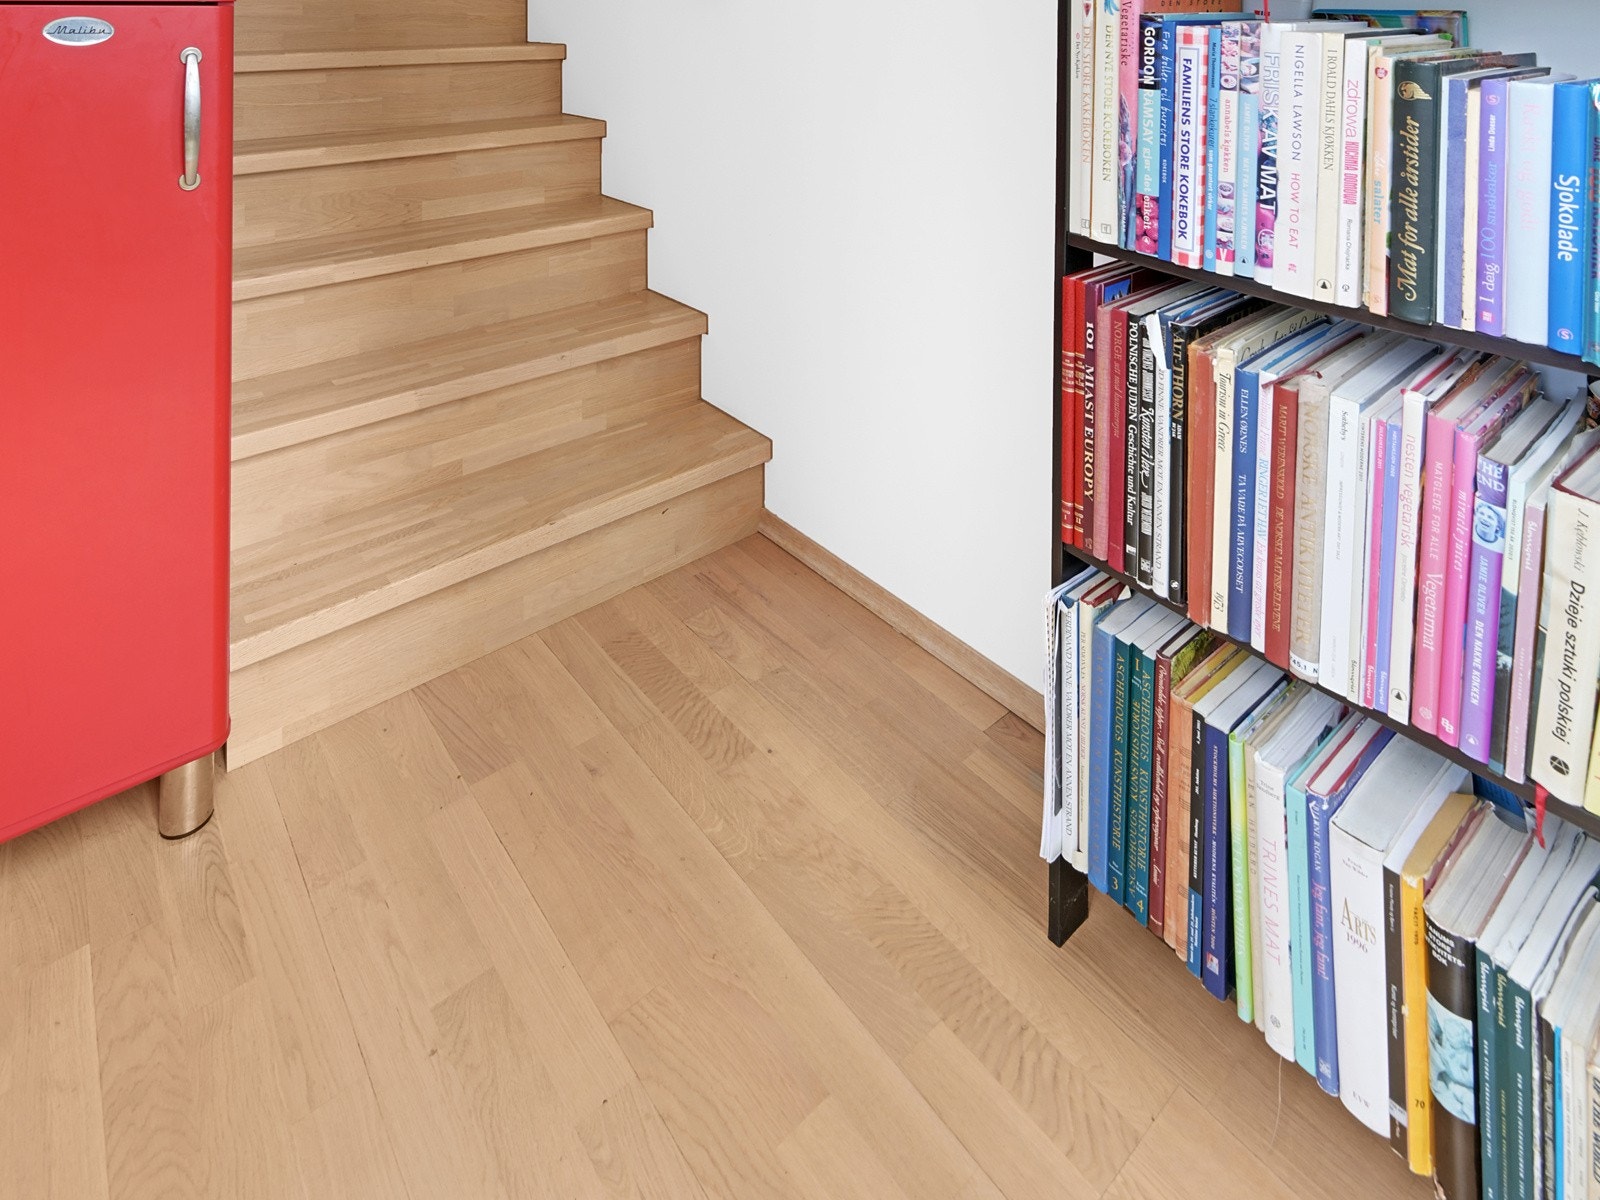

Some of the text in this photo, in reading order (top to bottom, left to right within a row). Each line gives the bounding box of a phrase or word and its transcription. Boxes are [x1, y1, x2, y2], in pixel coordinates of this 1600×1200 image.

[50, 25, 111, 36] Malibu
[1120, 1, 1132, 67] Vegetariske
[1161, 0, 1181, 7] DEN
[1082, 25, 1091, 163] DEN STORE KAKEBOKEN
[1102, 24, 1114, 183] DEN NYE STORE KOKEBOKEN
[1142, 27, 1155, 230] GORDON RAMSAY det enkelt
[1160, 87, 1171, 147] til burritos
[1208, 103, 1217, 148] slankekurer
[1322, 55, 1337, 171] ROALD DAHLS KJØKKEN
[1178, 58, 1192, 240] FAMILIENS STORE KOKEBOK
[1220, 99, 1232, 173] annabels kjøkken
[1259, 51, 1281, 216] FRISK AV MAT
[1289, 45, 1304, 249] NIGELLA LAWSON HOW TO EAT
[1343, 79, 1361, 206] zdrowa KUCHNIA DOMOWA
[1374, 179, 1386, 225] salater
[1397, 115, 1425, 302] Mat for alle årstider
[1555, 174, 1581, 262] Sjokolade
[1484, 262, 1500, 292] deig
[1113, 321, 1122, 361] NORGE
[1084, 321, 1095, 502] 101 MIAST EUROPY
[1126, 321, 1139, 526] POLNISCHE JUDEN Geschichte und Kultur
[1139, 407, 1154, 449] Kunsten
[1217, 372, 1232, 453] Tourism in Greece
[1339, 410, 1349, 442] Sotheby's
[1235, 388, 1249, 594] ELLEN ØRNES TA VARE PÅ ARVEGODSET
[1274, 404, 1288, 555] MARIT WERENSKIOLD DE NORSKE
[1400, 434, 1418, 549] nesten vegetarisk
[1429, 461, 1443, 560] MATGLEDE FOR ALLE
[1455, 489, 1470, 534] miracle
[1154, 532, 1162, 569] STRAND
[1256, 519, 1267, 541] HAV
[1295, 402, 1321, 645] NORSKE ANTIKVITETER
[1422, 572, 1443, 652] Vegetarmat
[1470, 555, 1488, 706] JAMIE OLIVER DEN NAKNE KOKKEN
[1114, 652, 1125, 744] ASCHEHOUGS
[1551, 580, 1586, 745] Dzieje sztuki polskiej
[1065, 691, 1073, 730] VANDRER
[1139, 670, 1151, 762] ASCHEHOUGS
[1066, 751, 1073, 766] EN
[1065, 801, 1073, 836] STRAND
[1112, 748, 1124, 851] KUNSTHISTORIE
[1137, 768, 1150, 872] KUNSTHISTORIE
[1111, 876, 1119, 890] 3
[1312, 880, 1327, 902] Jeg
[1313, 839, 1322, 873] ROGAN
[1136, 900, 1144, 913] 4
[1262, 837, 1281, 967] TRINES MAT
[1312, 930, 1328, 951] jeg
[1341, 897, 1377, 946] ARTS
[1346, 931, 1368, 954] 1996
[1432, 948, 1449, 967] BOK
[1415, 1098, 1425, 1109] 70
